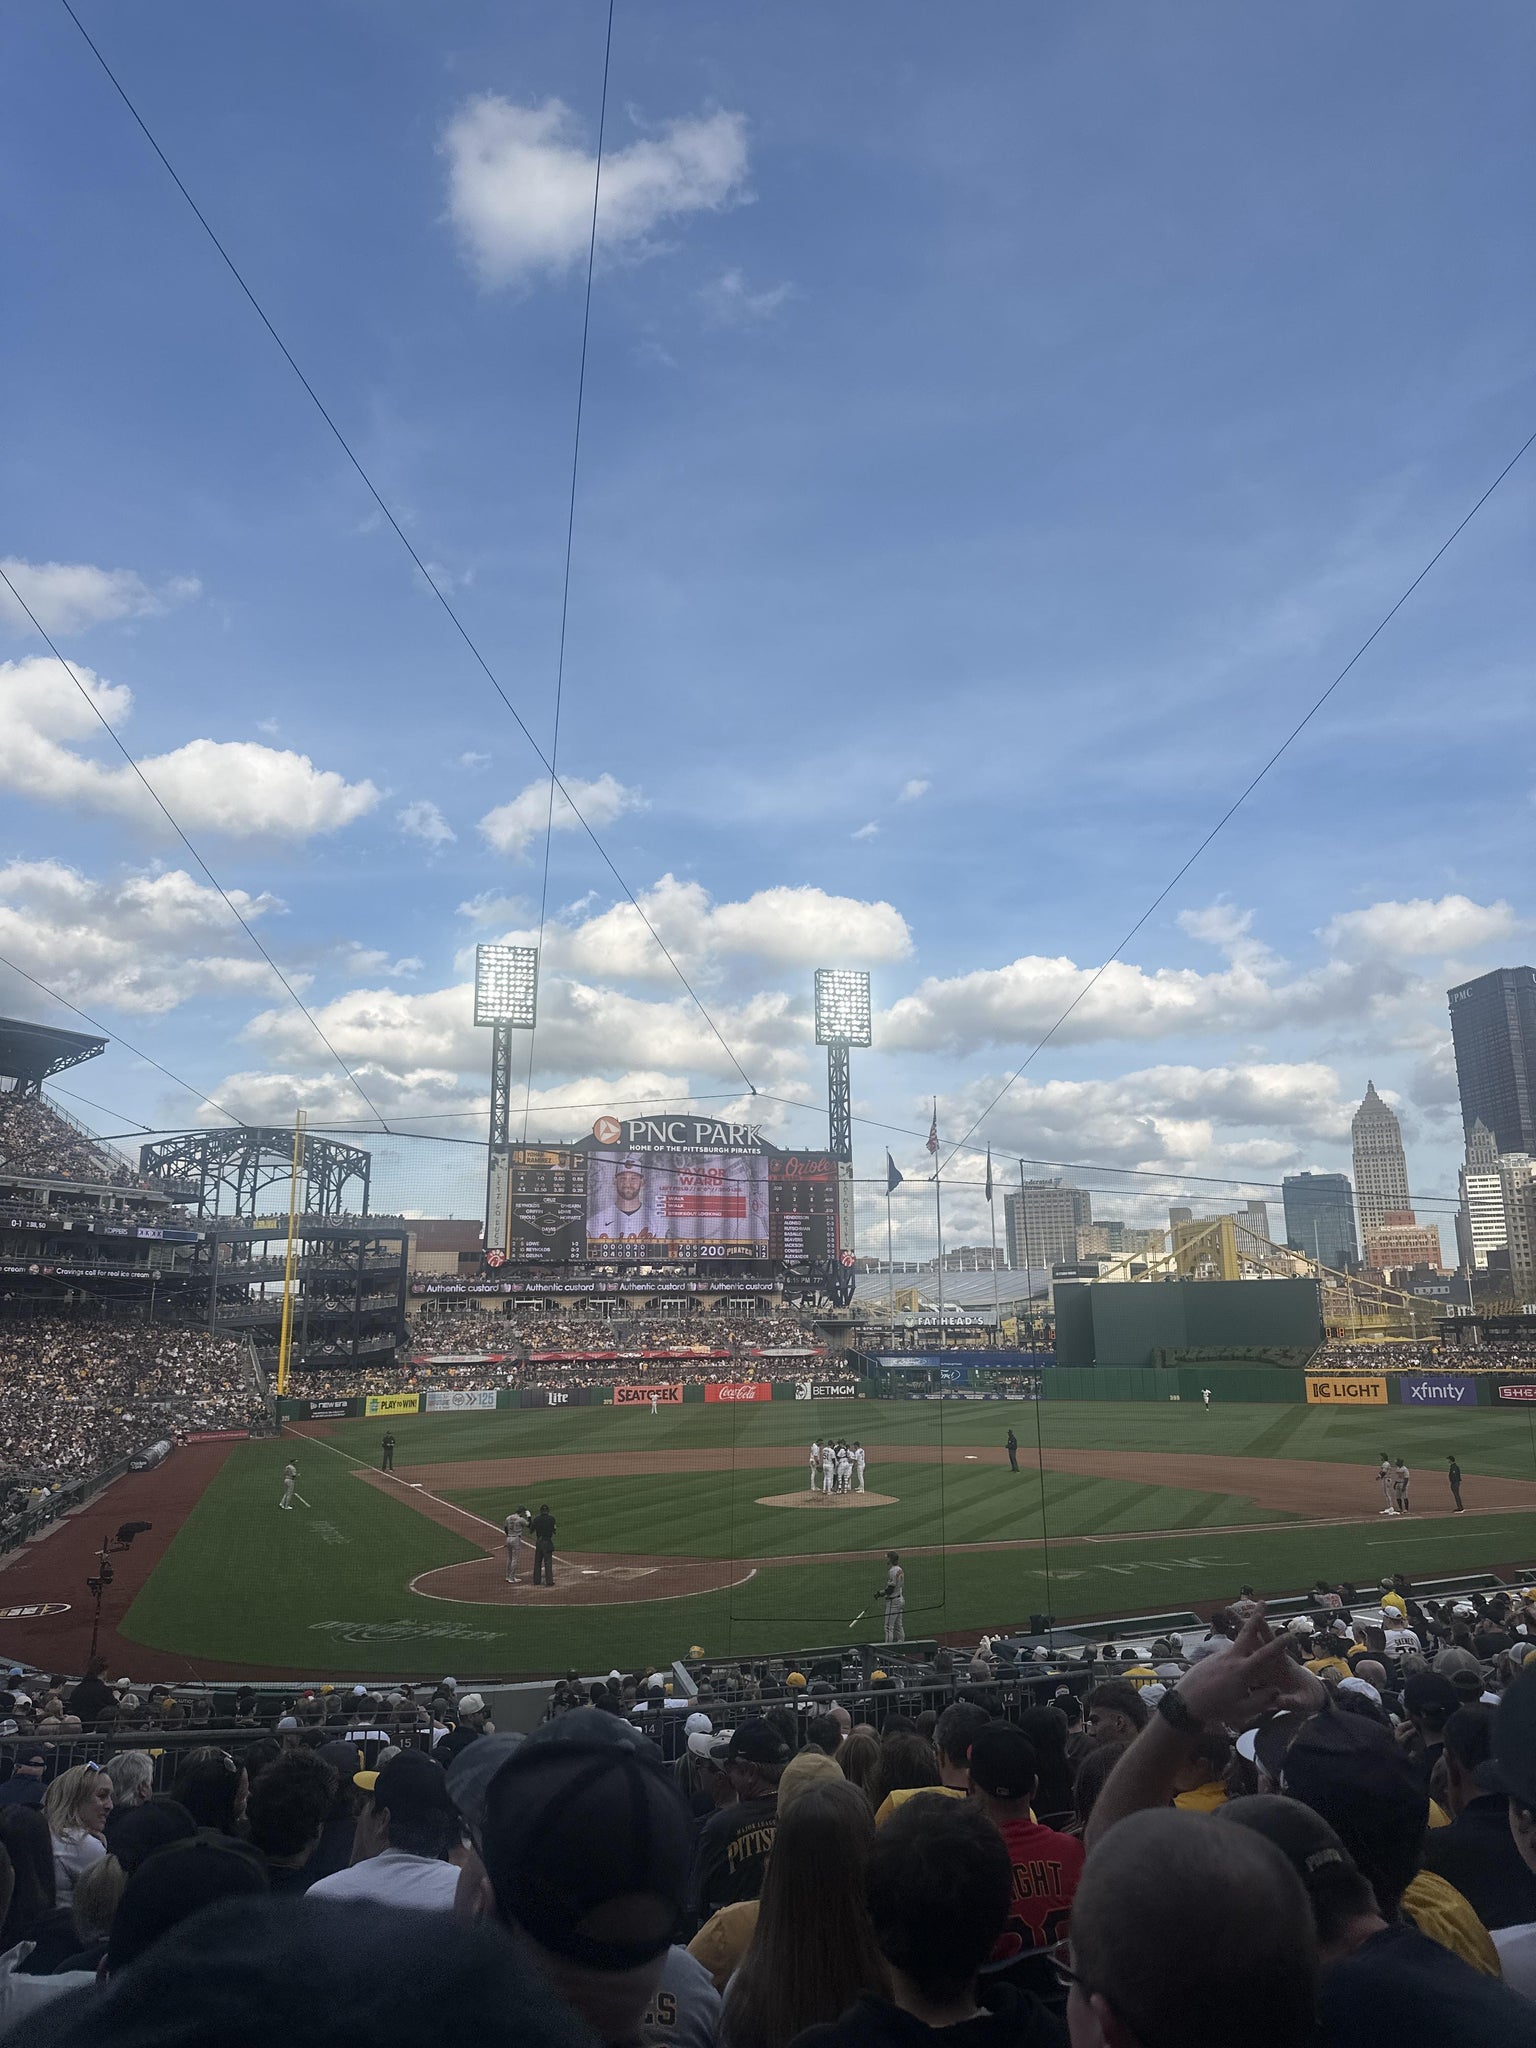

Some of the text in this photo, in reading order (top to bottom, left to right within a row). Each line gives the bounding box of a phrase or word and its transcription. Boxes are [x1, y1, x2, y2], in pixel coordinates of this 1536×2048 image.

[627, 1121, 762, 1146] PNC PARK
[731, 1147, 761, 1155] PIRATES
[786, 1157, 837, 1176] Orioles
[676, 1168, 727, 1176] TAYLOR
[680, 1177, 723, 1186] WARD
[700, 1246, 725, 1256] 200
[56, 1267, 84, 1276] Cravings
[426, 1284, 499, 1293] Authentic custard
[526, 1283, 594, 1292] Authentic custard
[619, 1283, 685, 1291] Authentic custard
[710, 1282, 772, 1291] Authentic custard
[918, 1316, 984, 1326] FAT HEAD'S
[617, 1388, 678, 1402] SEATGEEK
[719, 1385, 756, 1400] Coca-Cola
[813, 1386, 855, 1395] BETMGM
[1313, 1384, 1380, 1397] IC LIGHT
[1410, 1382, 1465, 1401] xfinity
[1503, 1389, 1536, 1397] SHE
[478, 1392, 494, 1405] 125
[548, 1392, 568, 1405] Lite
[381, 1400, 396, 1410] PLAY
[403, 1400, 417, 1408] WIN!
[1004, 1693, 1013, 1702] 14
[645, 1724, 655, 1733] 14
[401, 1738, 412, 1748] 15
